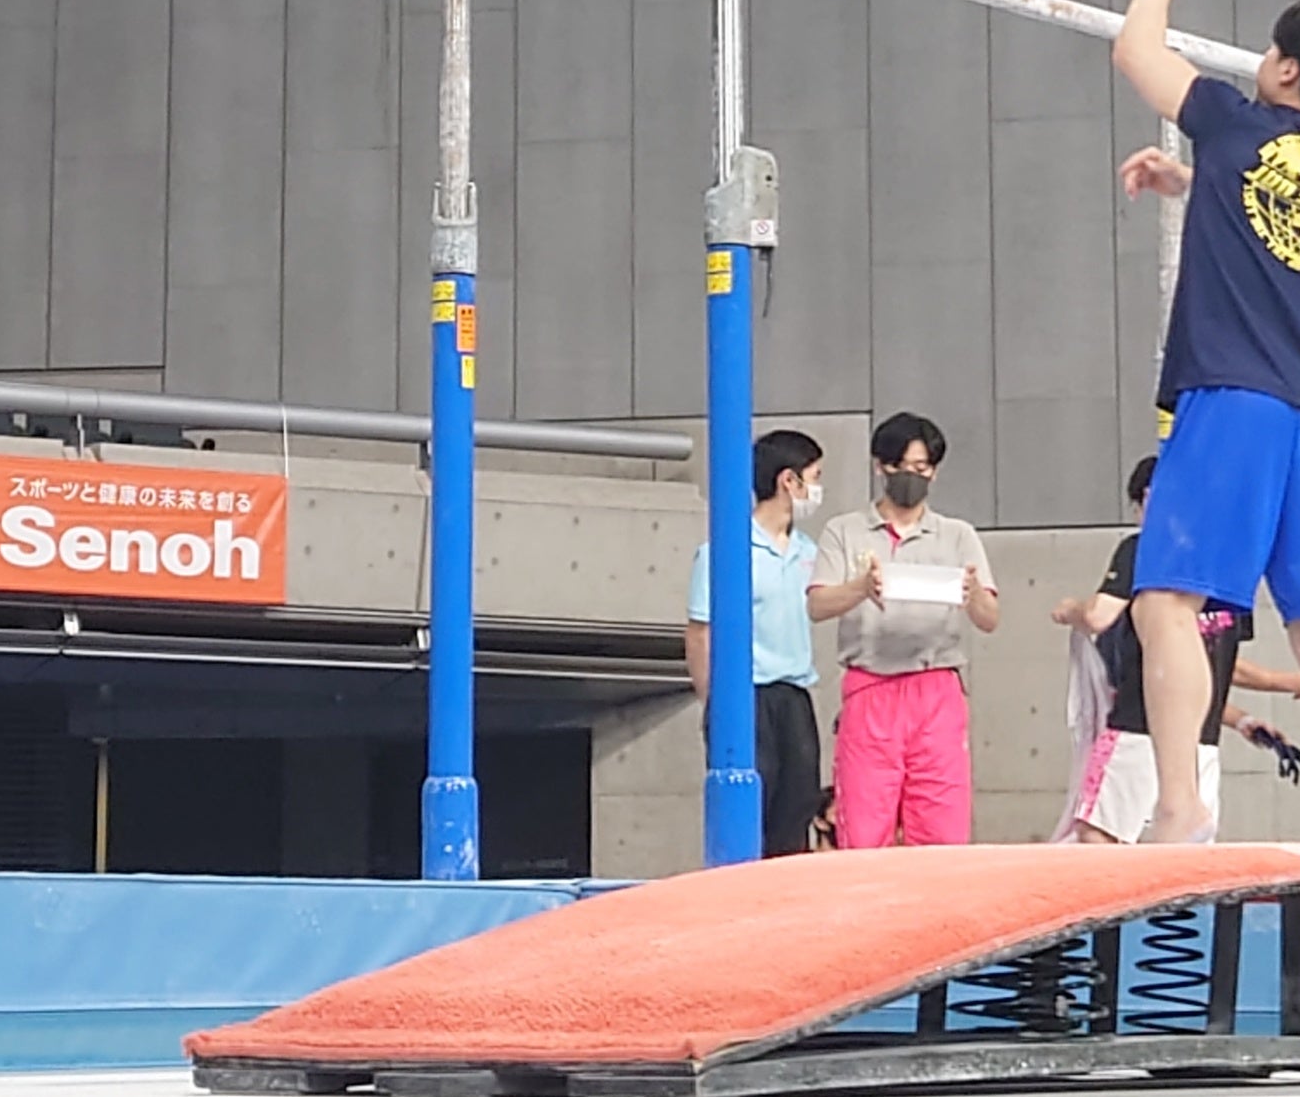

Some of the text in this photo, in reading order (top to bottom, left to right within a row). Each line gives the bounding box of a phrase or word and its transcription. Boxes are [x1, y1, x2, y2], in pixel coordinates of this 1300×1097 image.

[9, 476, 253, 514] スポーツと健康の未来を創る
[0, 505, 260, 580] Senoh
